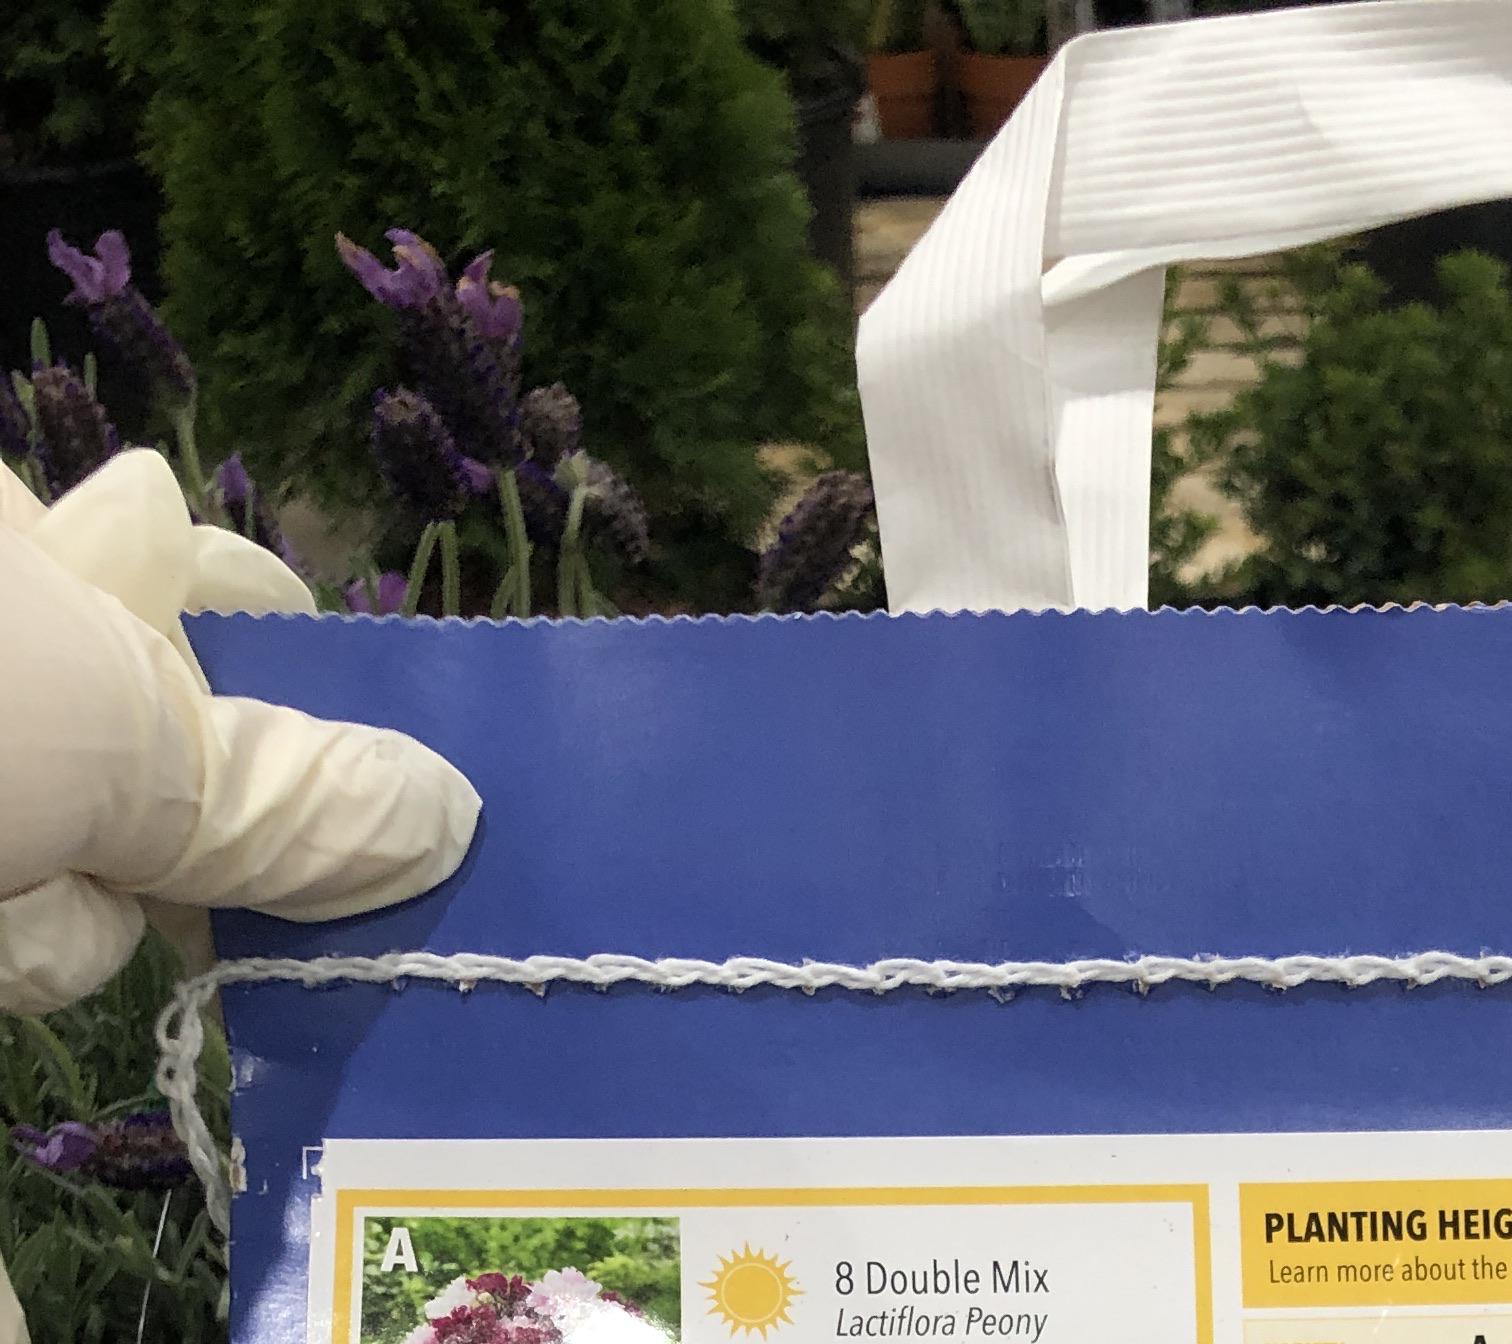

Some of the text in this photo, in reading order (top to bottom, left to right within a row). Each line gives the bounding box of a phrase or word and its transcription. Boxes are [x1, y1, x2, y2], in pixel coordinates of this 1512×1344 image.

[1264, 1209, 1427, 1244] PLANTING
[380, 1226, 420, 1273] A
[835, 1258, 1050, 1296] 8 Double Mix
[1269, 1259, 1329, 1284] Learn
[1336, 1263, 1394, 1282] more
[1401, 1255, 1466, 1282] about
[1471, 1254, 1508, 1280] the
[836, 1305, 1048, 1344] Lactiflora Peony
